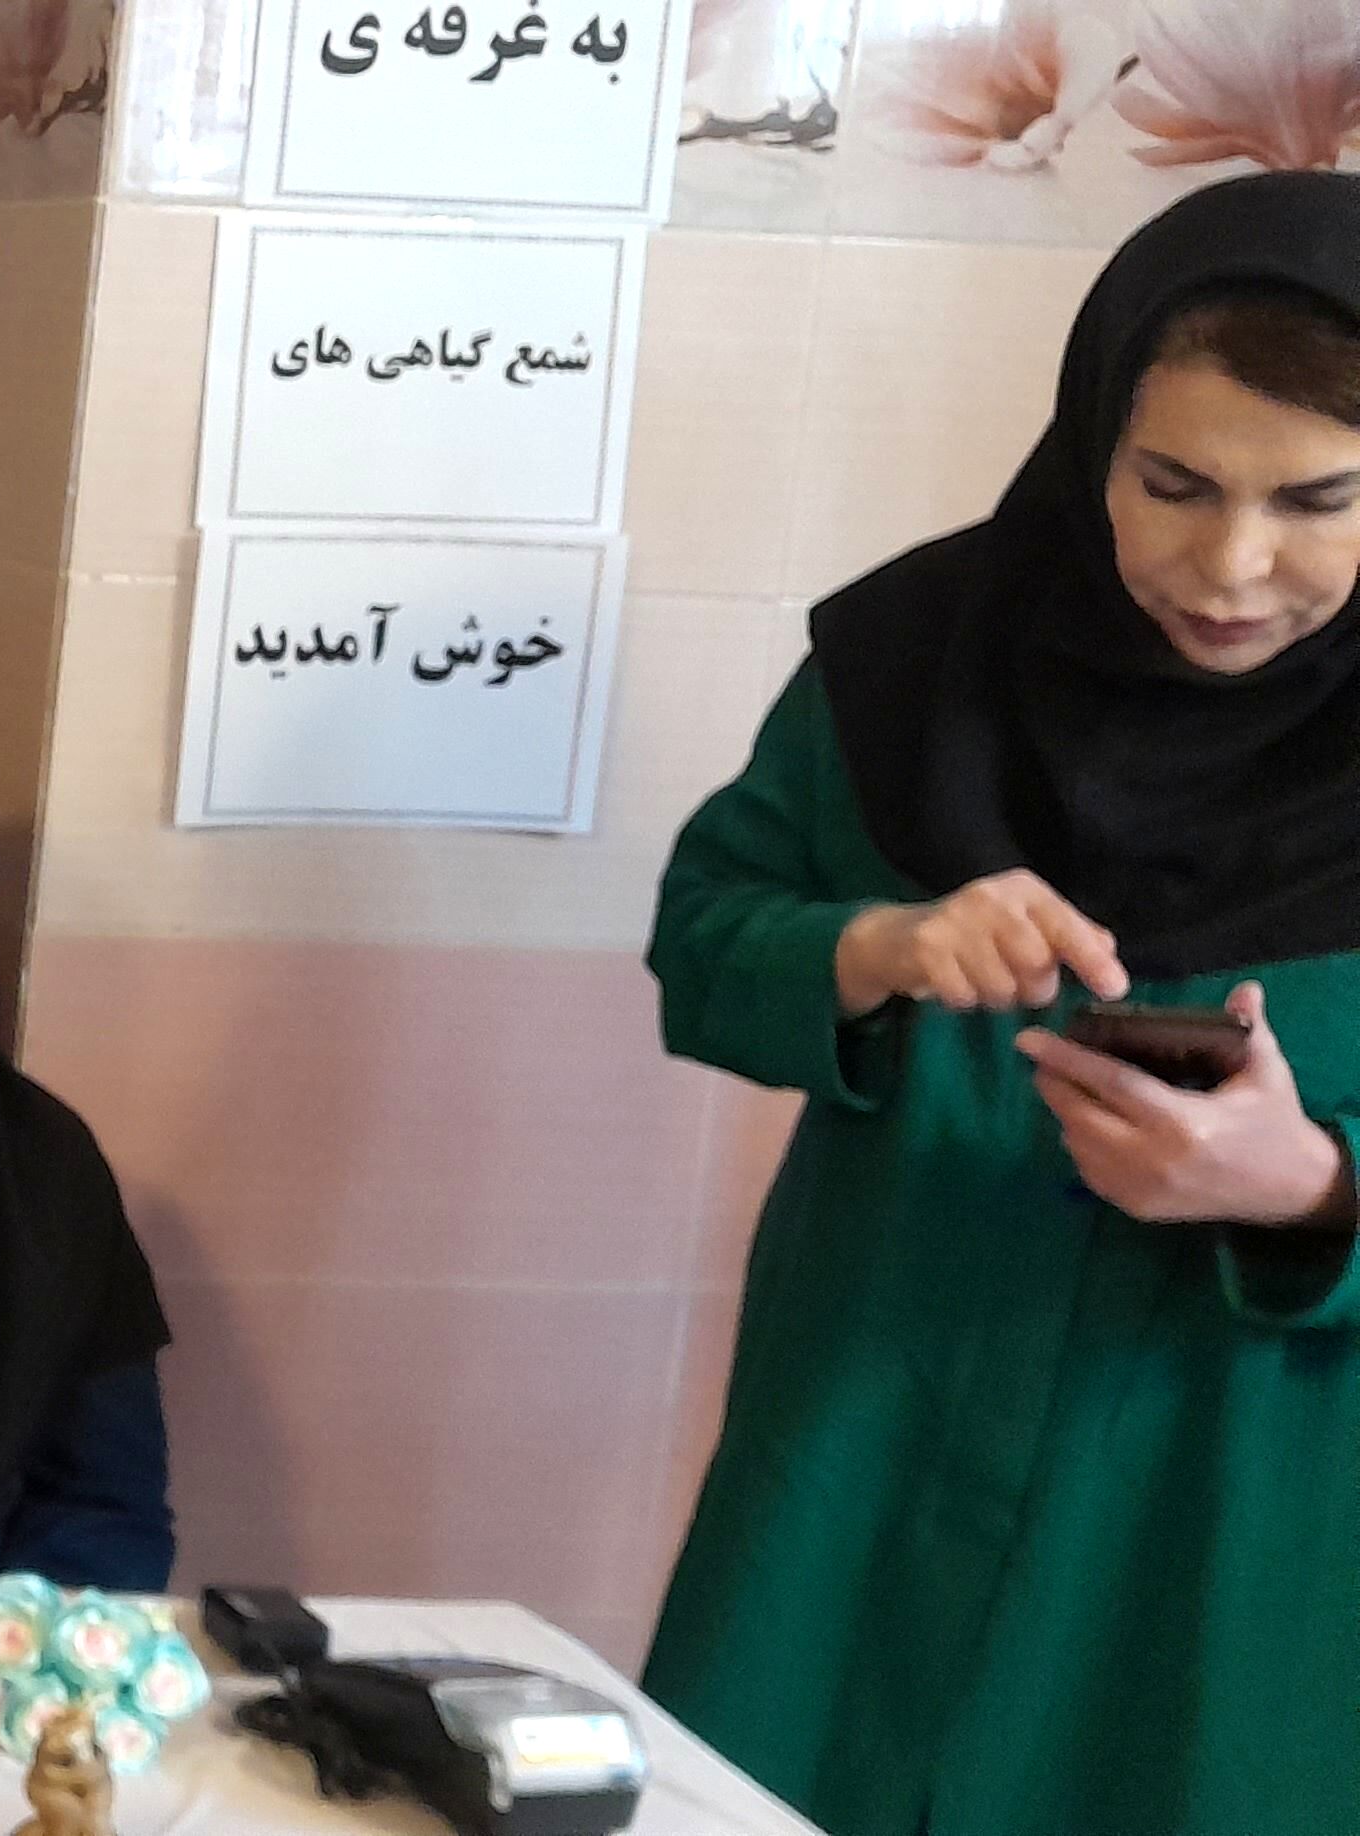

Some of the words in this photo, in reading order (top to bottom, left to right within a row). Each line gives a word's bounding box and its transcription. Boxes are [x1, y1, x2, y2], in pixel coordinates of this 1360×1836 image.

[320, 12, 381, 75] ی
[572, 14, 628, 85] به
[271, 324, 353, 378] های
[365, 327, 493, 381] گیاهی
[504, 331, 592, 386] شمع
[235, 601, 400, 678] آمدید
[411, 614, 564, 686] خوش
